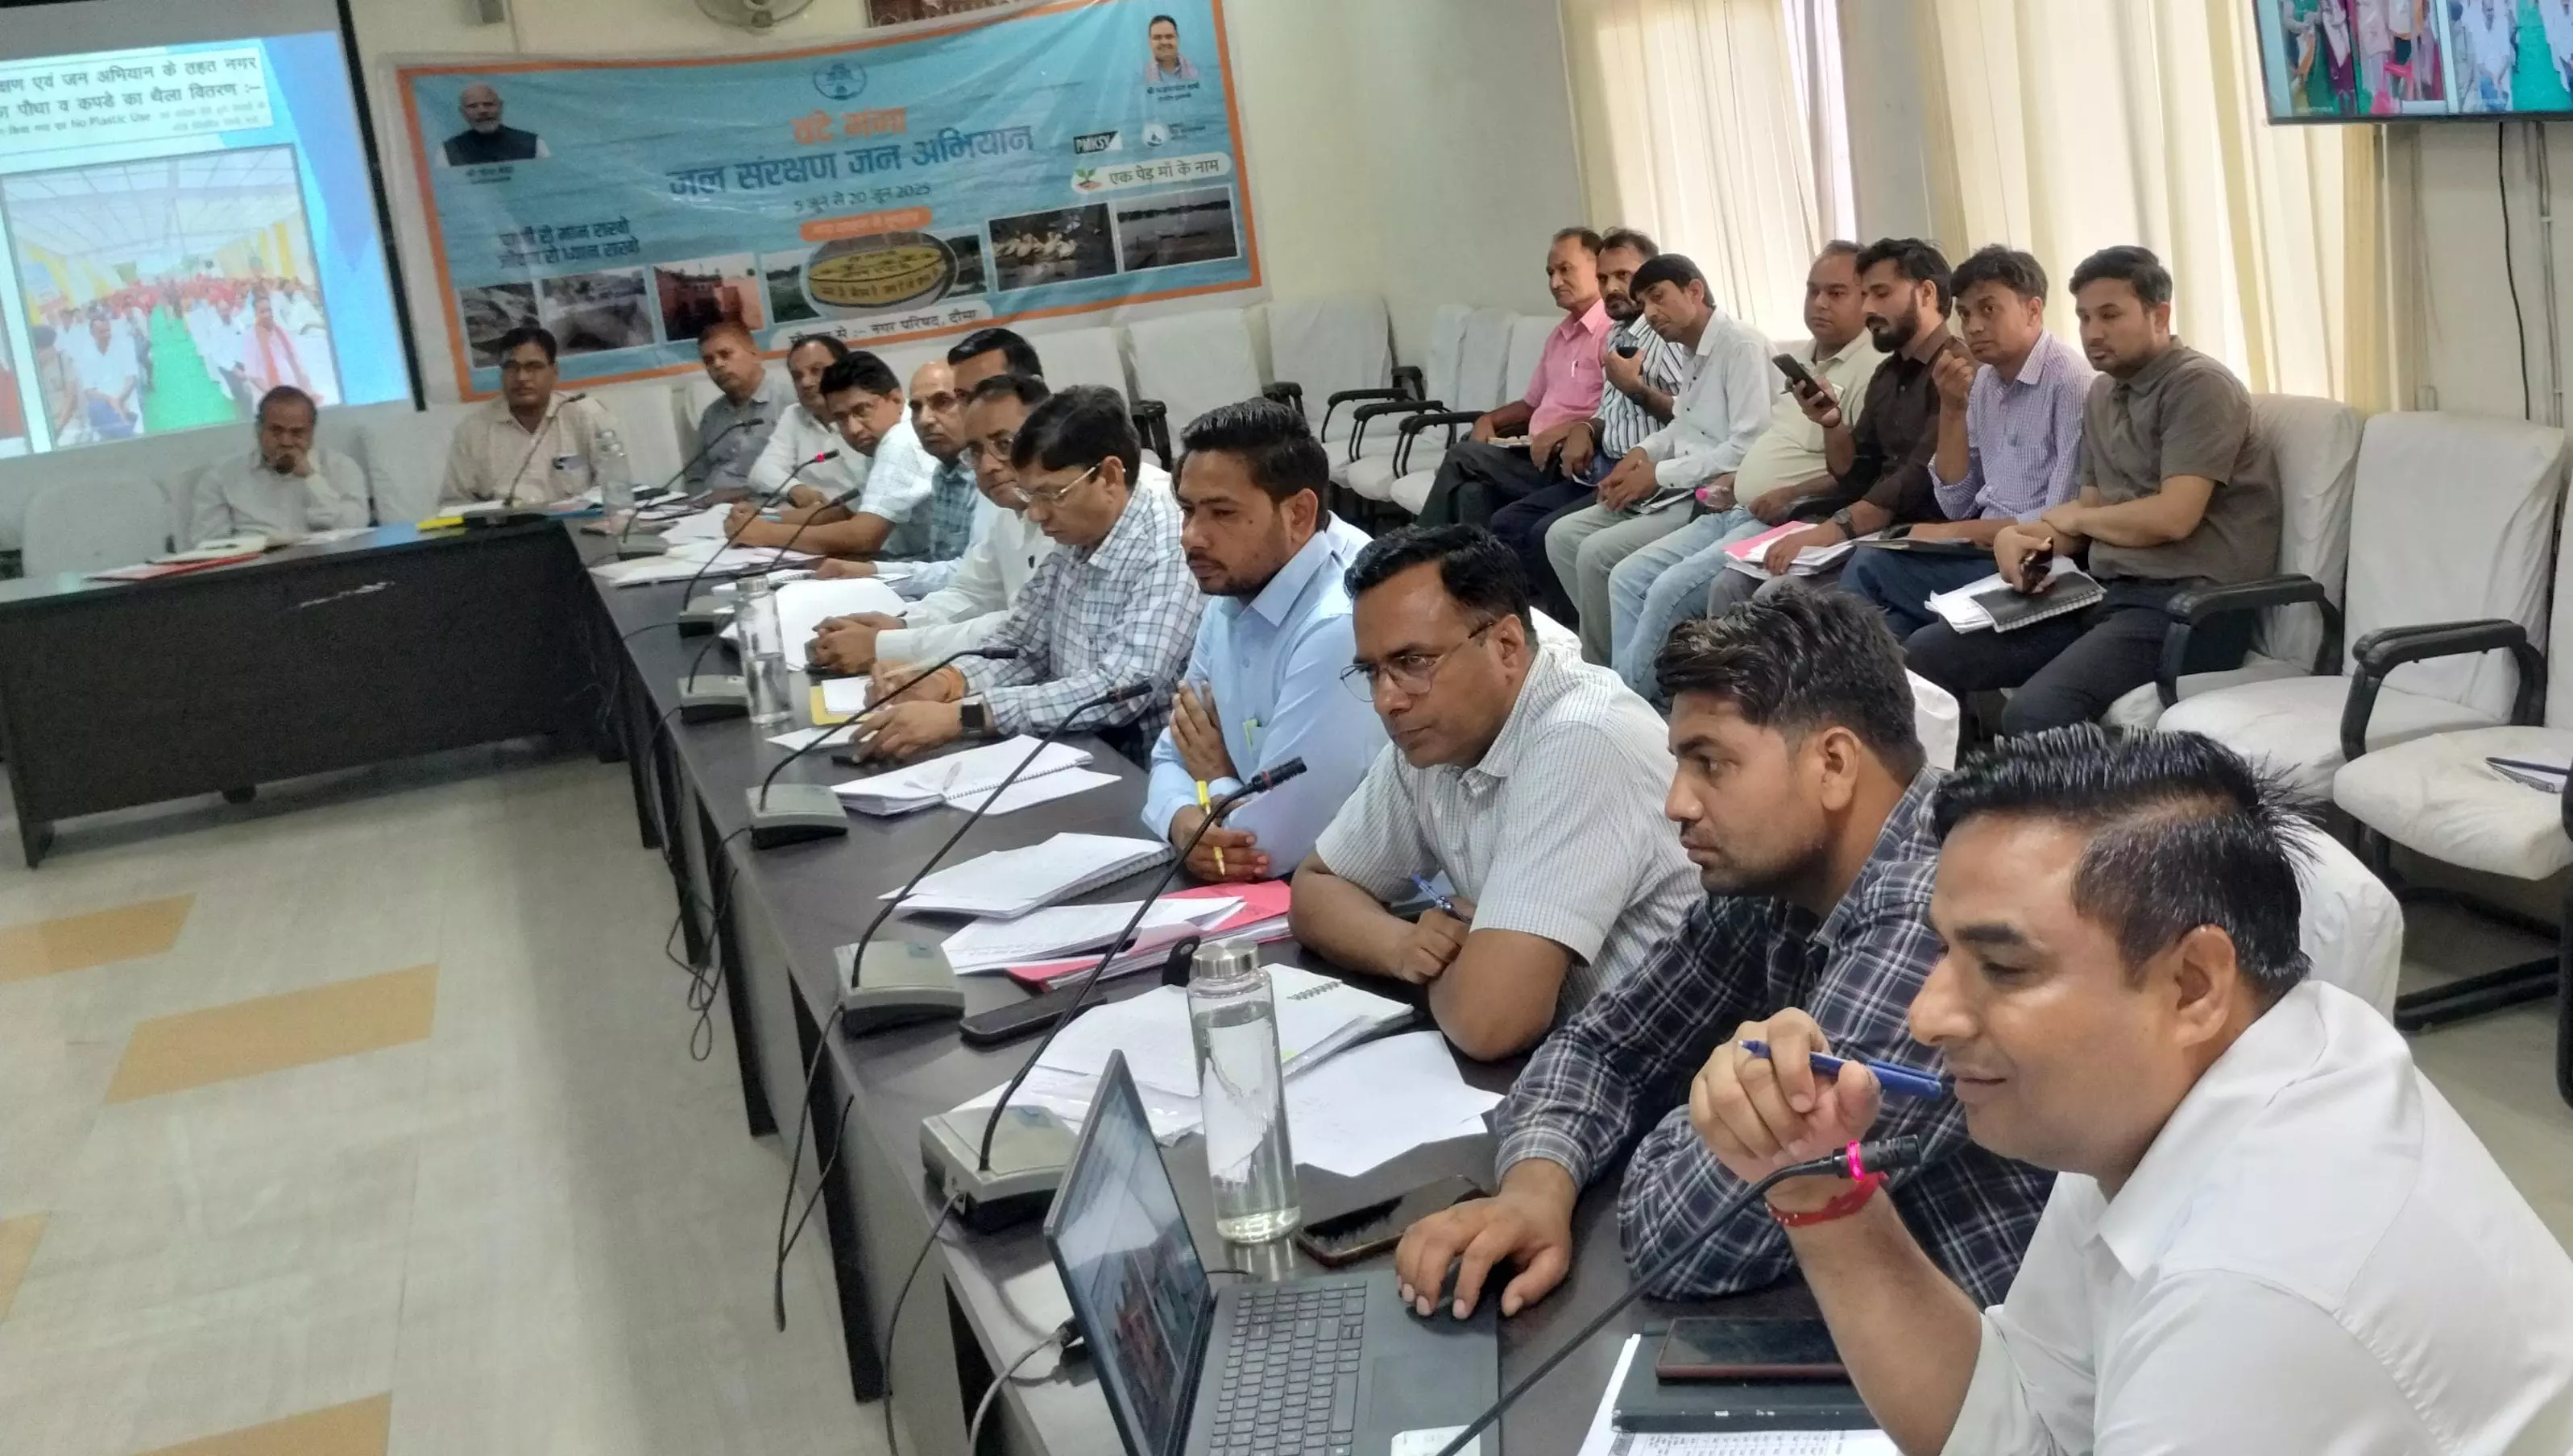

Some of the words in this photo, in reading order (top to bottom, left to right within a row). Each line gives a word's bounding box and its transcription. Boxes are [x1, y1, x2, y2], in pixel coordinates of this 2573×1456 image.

[61, 72, 88, 86] जन
[97, 65, 154, 83] अभियान
[161, 60, 177, 77] के
[184, 60, 217, 75] तहत
[224, 57, 258, 71] नगर
[56, 100, 69, 111] व
[122, 93, 143, 105] का
[151, 86, 182, 103] थैला
[188, 83, 238, 100] वितरण
[665, 166, 727, 196] जल
[732, 153, 839, 190] संरक्षण
[844, 144, 903, 175] जन
[911, 126, 1035, 168] अभियान
[1108, 170, 1133, 185] एक
[1178, 159, 1191, 176] के
[1195, 159, 1220, 173] नाम
[847, 191, 868, 205] 20
[895, 183, 932, 199] 2025
[870, 322, 895, 334] नगर
